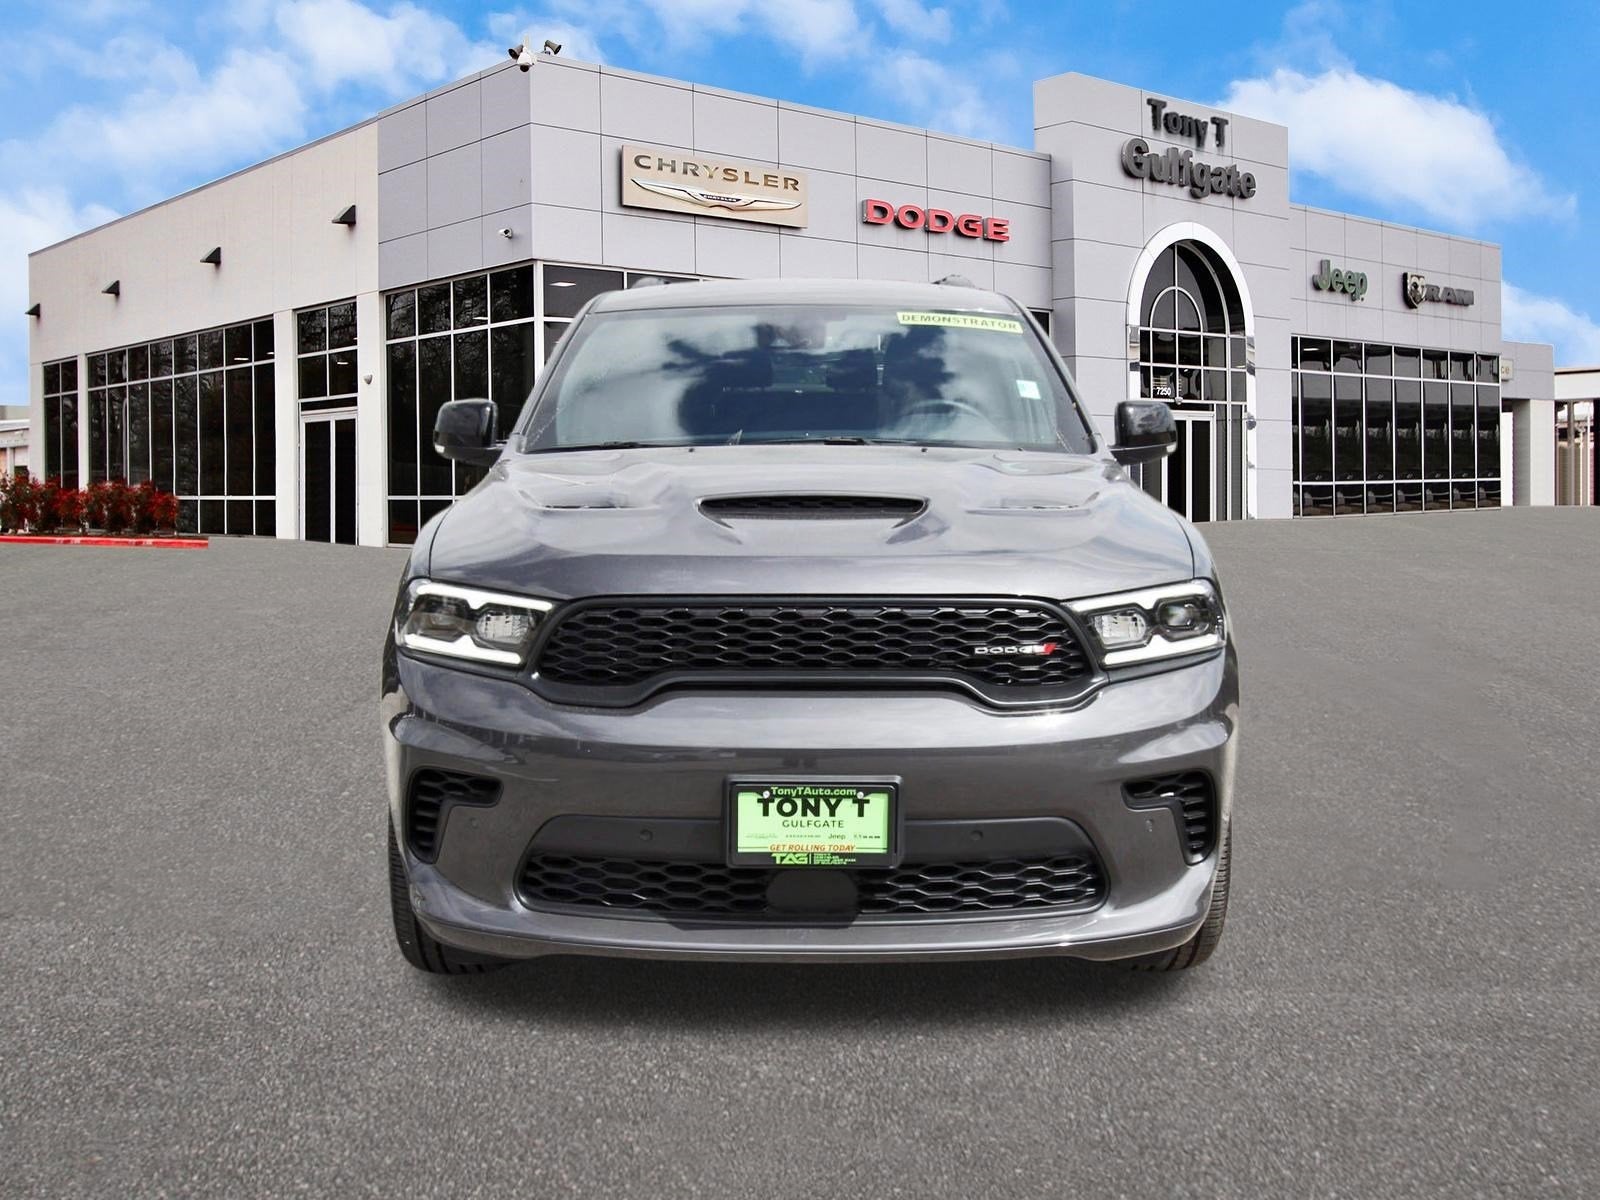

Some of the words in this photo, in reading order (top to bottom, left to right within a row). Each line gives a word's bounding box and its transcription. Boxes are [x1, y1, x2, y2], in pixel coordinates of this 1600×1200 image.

[1146, 98, 1208, 148] Tony
[1210, 116, 1229, 147] T
[634, 154, 800, 191] CHRYSLER
[1121, 138, 1256, 199] Gulfgate
[862, 199, 1010, 242] DODGE
[1312, 259, 1368, 302] Jeep
[1424, 284, 1475, 306] RAM
[902, 314, 1017, 330] DEMONSTRATOR
[1156, 387, 1172, 396] 7250
[771, 787, 856, 797] TonyTAuto.com
[757, 798, 842, 817] TONY
[853, 799, 870, 817] T
[782, 820, 845, 828] GULFGATE
[770, 844, 786, 852] GET
[788, 844, 826, 852] ROLLING
[828, 844, 856, 852] TODAY
[771, 853, 808, 865] TAG
